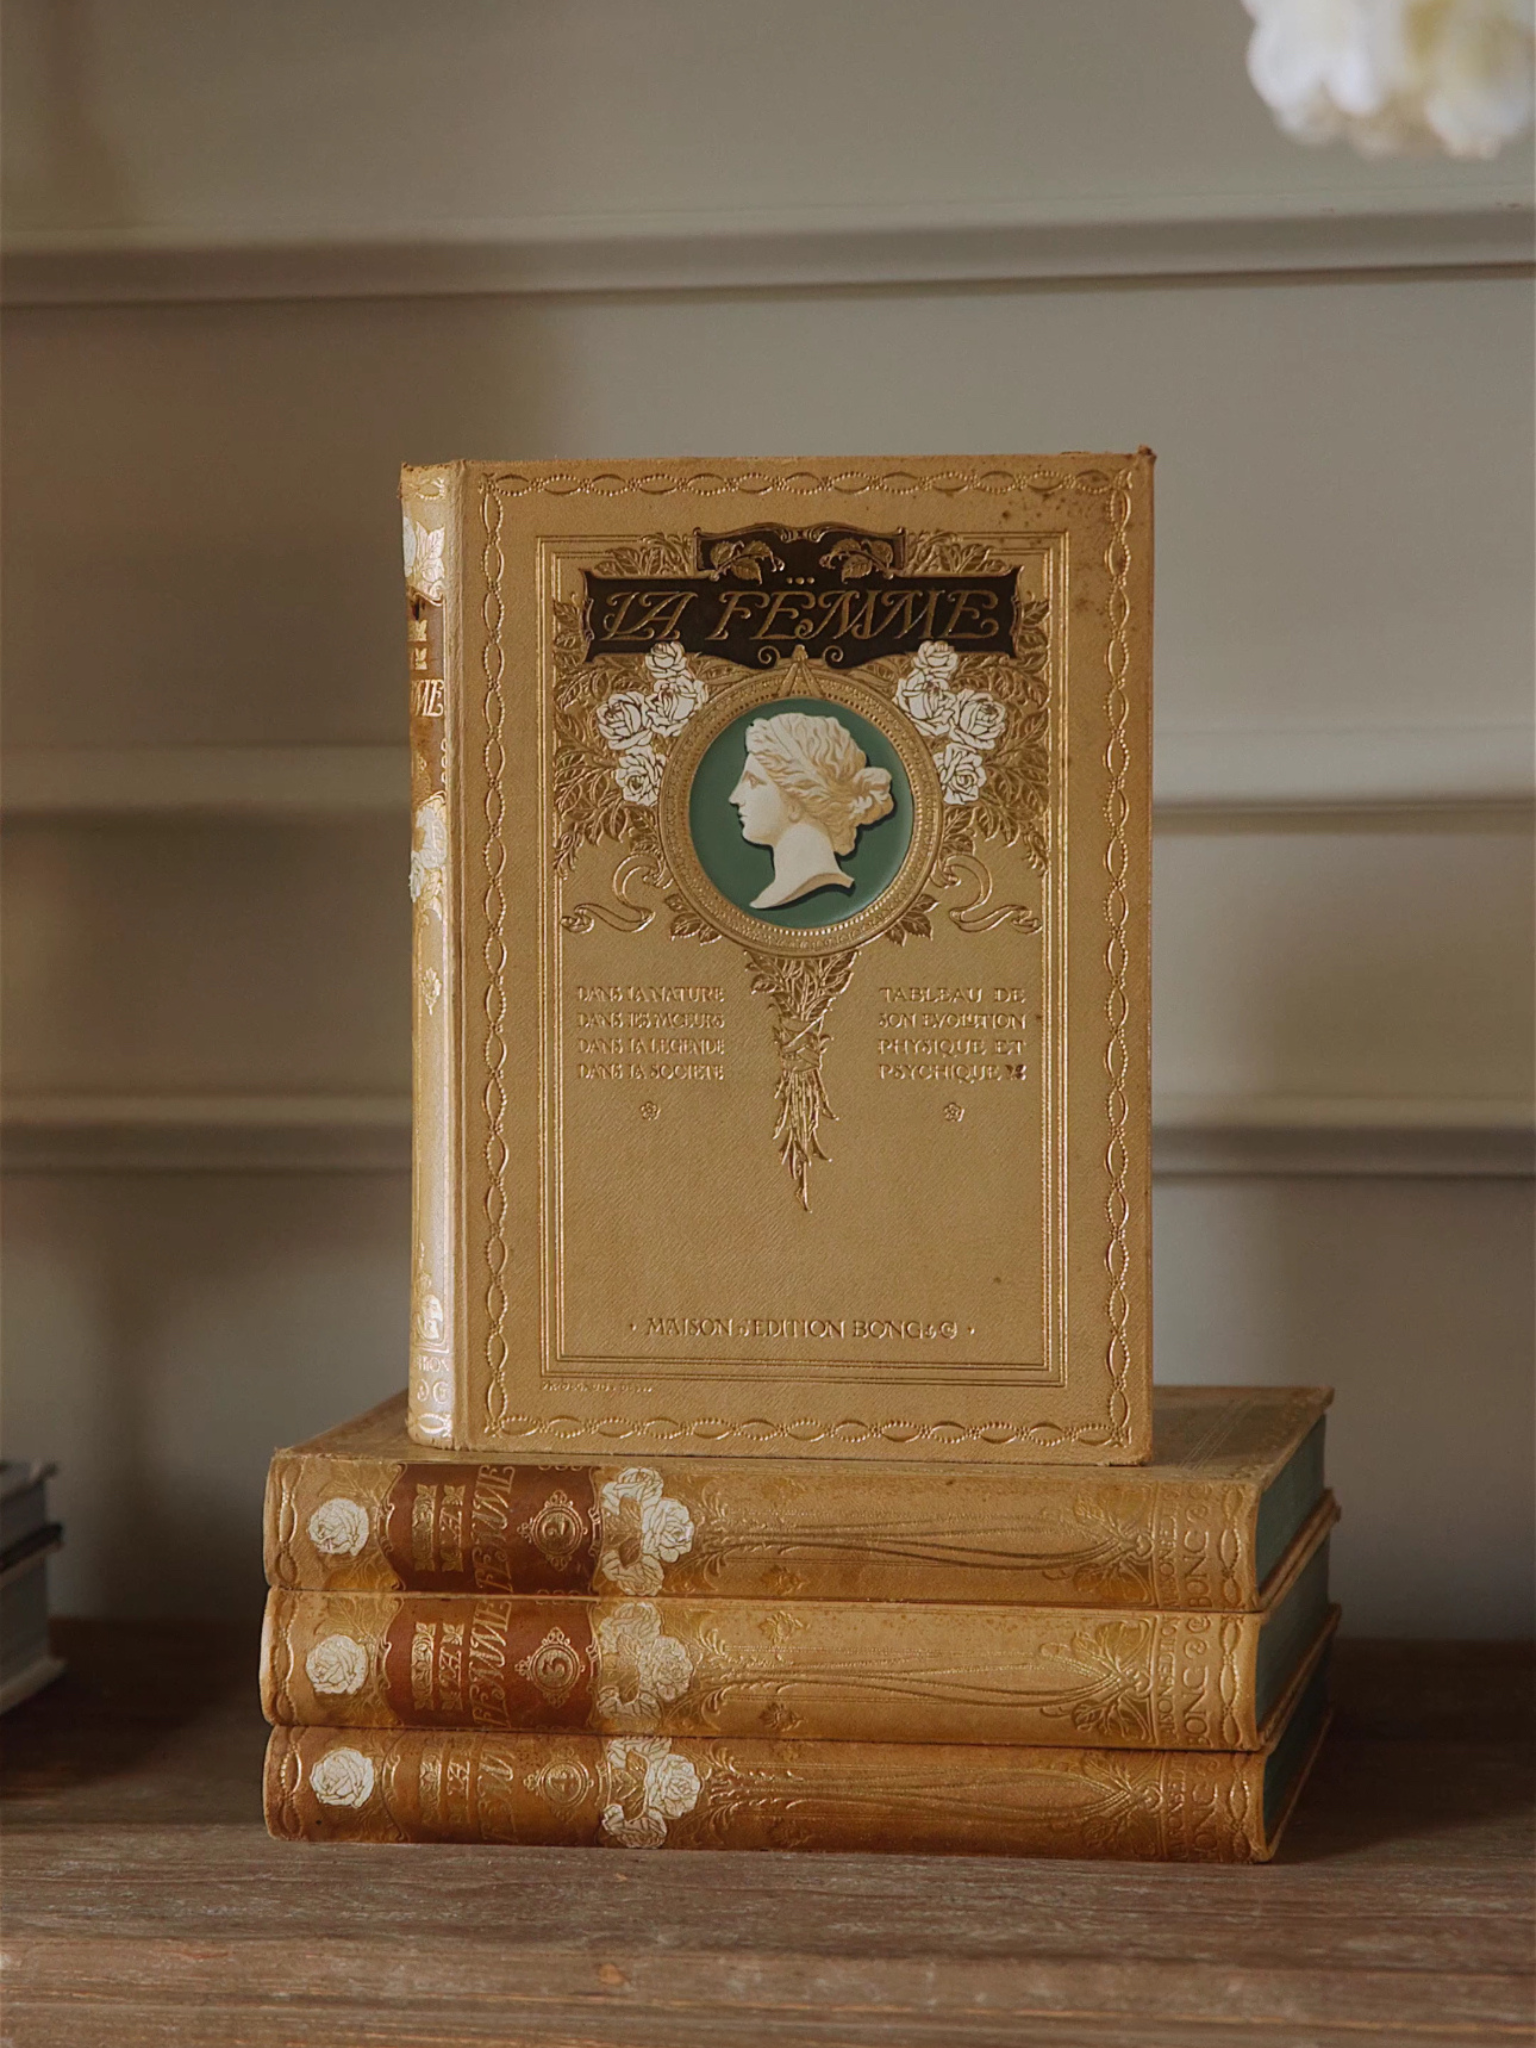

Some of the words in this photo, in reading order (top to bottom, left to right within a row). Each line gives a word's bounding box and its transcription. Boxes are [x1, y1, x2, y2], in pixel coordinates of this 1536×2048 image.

[600, 590, 699, 641] LA
[705, 589, 999, 641] FEMME
[577, 986, 624, 1002] DANS
[650, 986, 725, 1003] NATURE
[879, 986, 983, 1003] TABLEAU
[993, 986, 1026, 1003] DE
[577, 1012, 624, 1029] DANS
[879, 1012, 917, 1029] SON
[922, 1012, 1027, 1030] EVOLUTION
[577, 1037, 624, 1055] DANS
[878, 1038, 987, 1058] PHYSIQUE
[993, 1038, 1027, 1056] ET
[577, 1063, 624, 1080] DANS
[878, 1063, 1003, 1085] PSYCHIQUE
[645, 1317, 734, 1339] MAISON
[852, 1319, 924, 1340] BONG
[471, 1464, 514, 1594] FEMME
[469, 1600, 513, 1729] FEMME
[541, 1656, 566, 1678] 3
[1183, 1665, 1213, 1746] BONG
